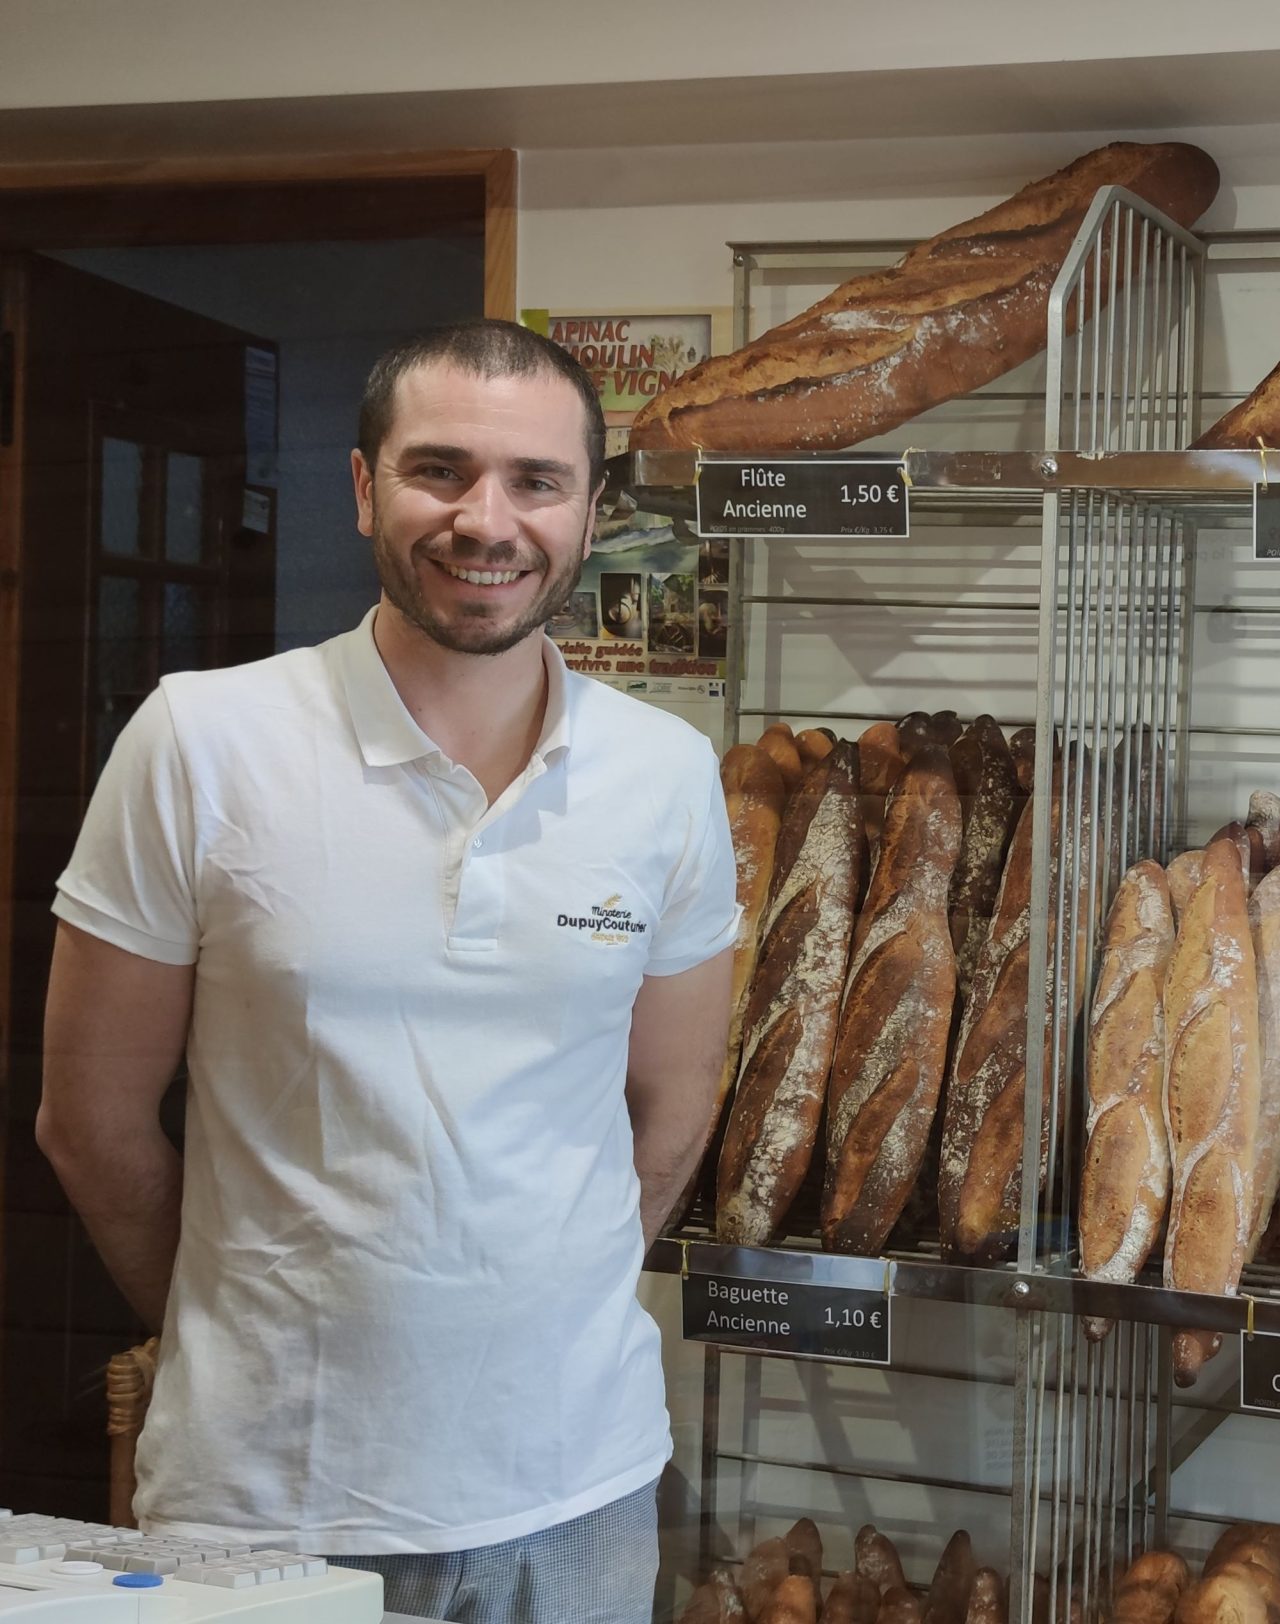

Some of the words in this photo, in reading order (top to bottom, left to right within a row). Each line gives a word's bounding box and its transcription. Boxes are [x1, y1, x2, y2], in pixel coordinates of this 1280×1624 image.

[551, 320, 631, 343] APINAC
[614, 370, 680, 396] VIGN
[741, 468, 786, 487] Flûte
[840, 485, 882, 506] 1,50
[886, 485, 899, 503] €
[723, 500, 807, 518] Ancienne
[768, 525, 785, 534] 400g
[708, 1280, 789, 1306] Baguette
[706, 1310, 790, 1336] Ancienne
[824, 1307, 865, 1328] 1,10
[869, 1312, 882, 1329] €
